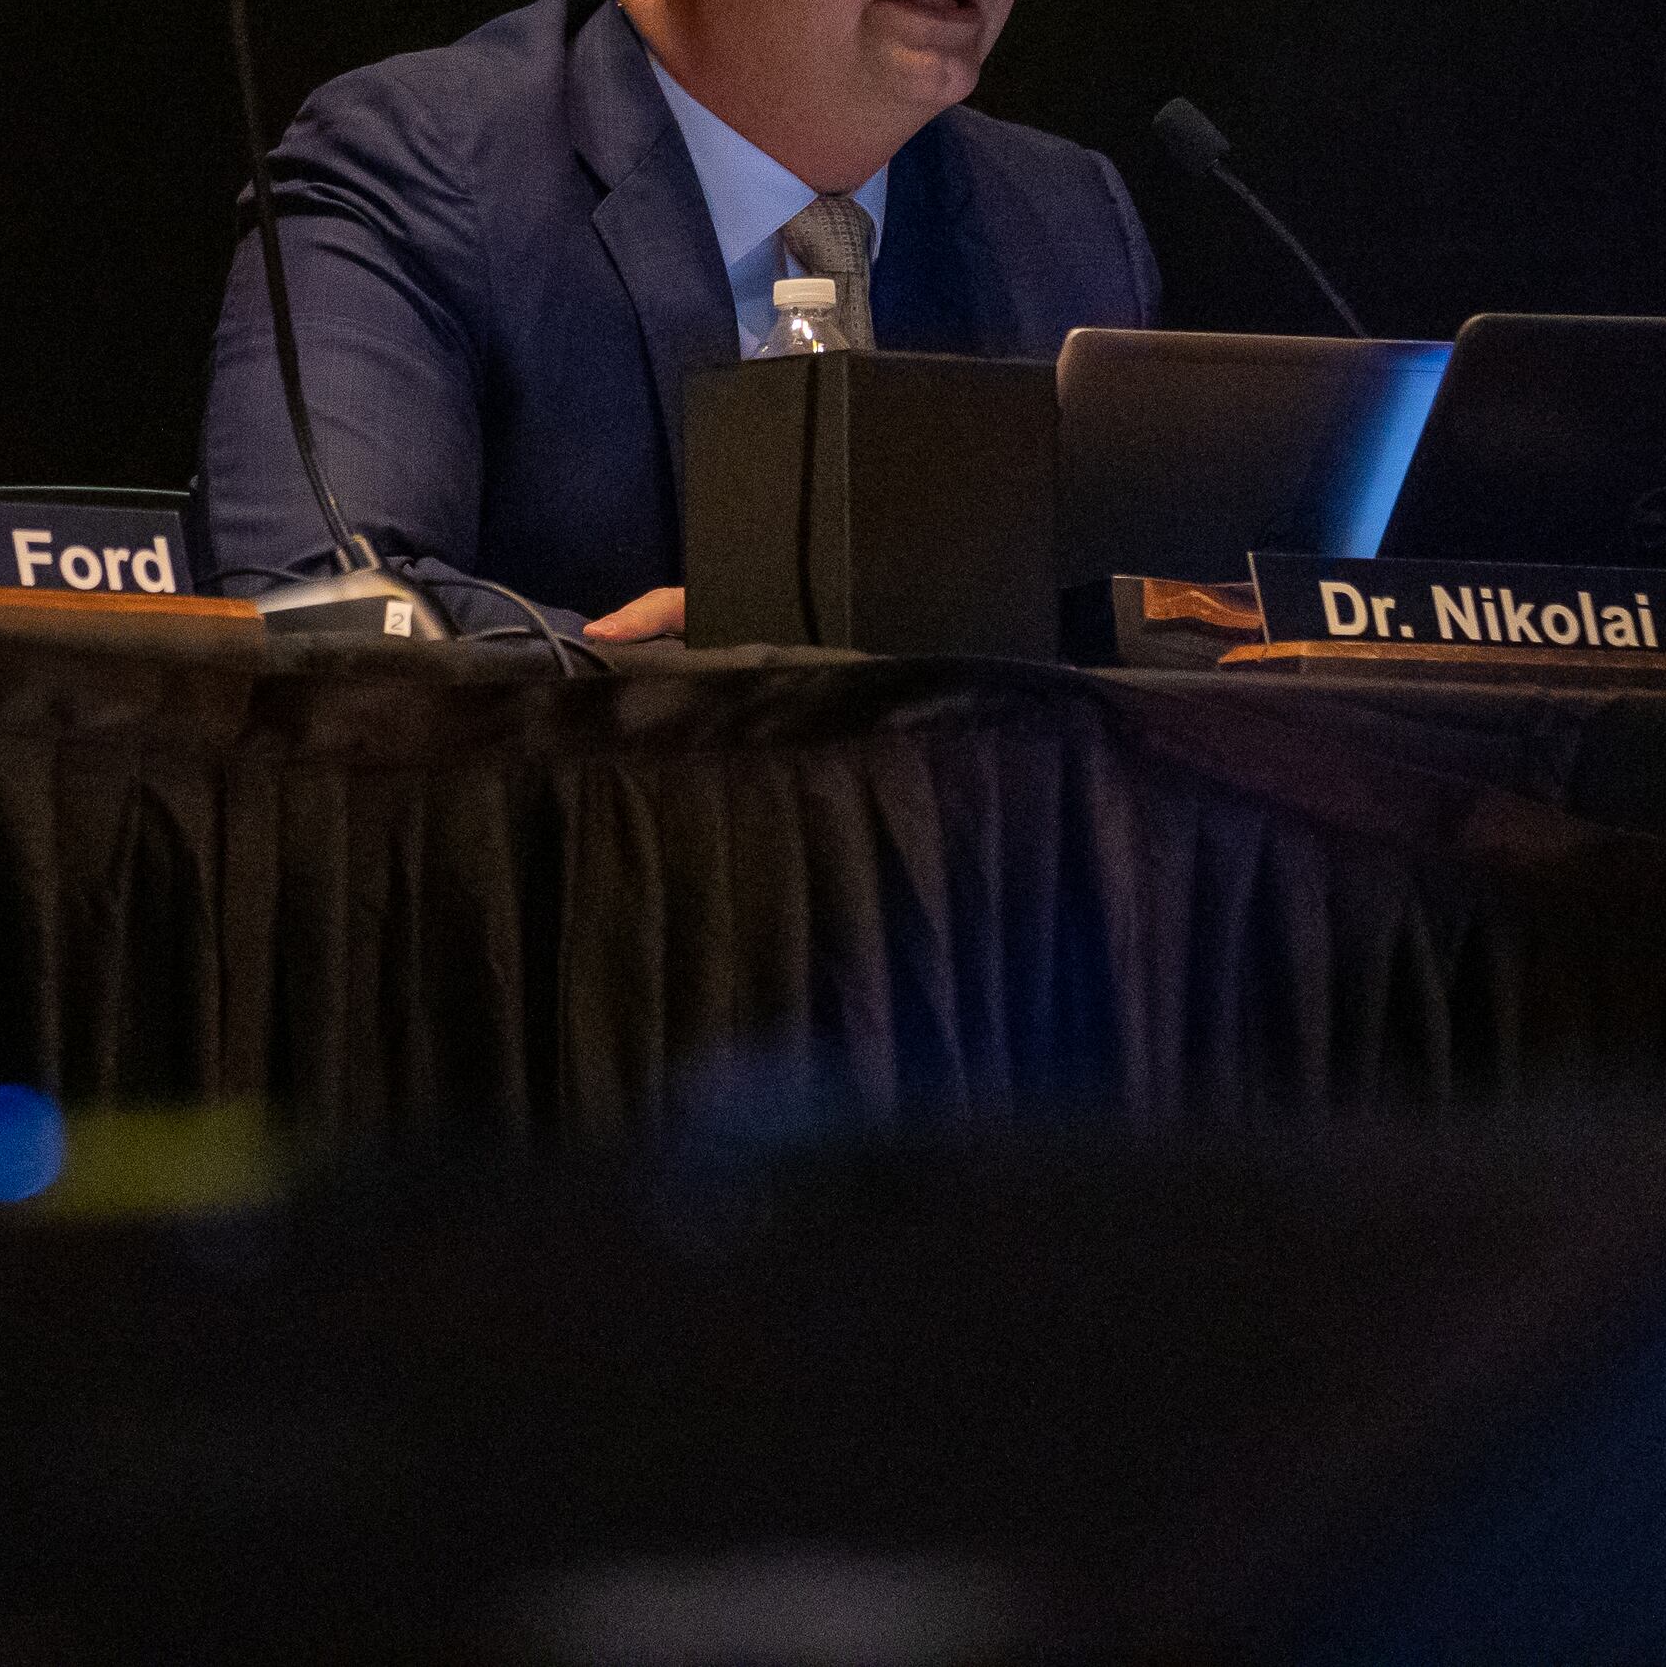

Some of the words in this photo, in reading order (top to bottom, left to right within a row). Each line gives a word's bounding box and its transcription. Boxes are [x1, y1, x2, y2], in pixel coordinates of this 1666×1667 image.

[12, 529, 176, 594] Ford
[391, 613, 404, 631] 2
[1319, 580, 1414, 638] Dr.
[1430, 585, 1658, 647] Nikolai
